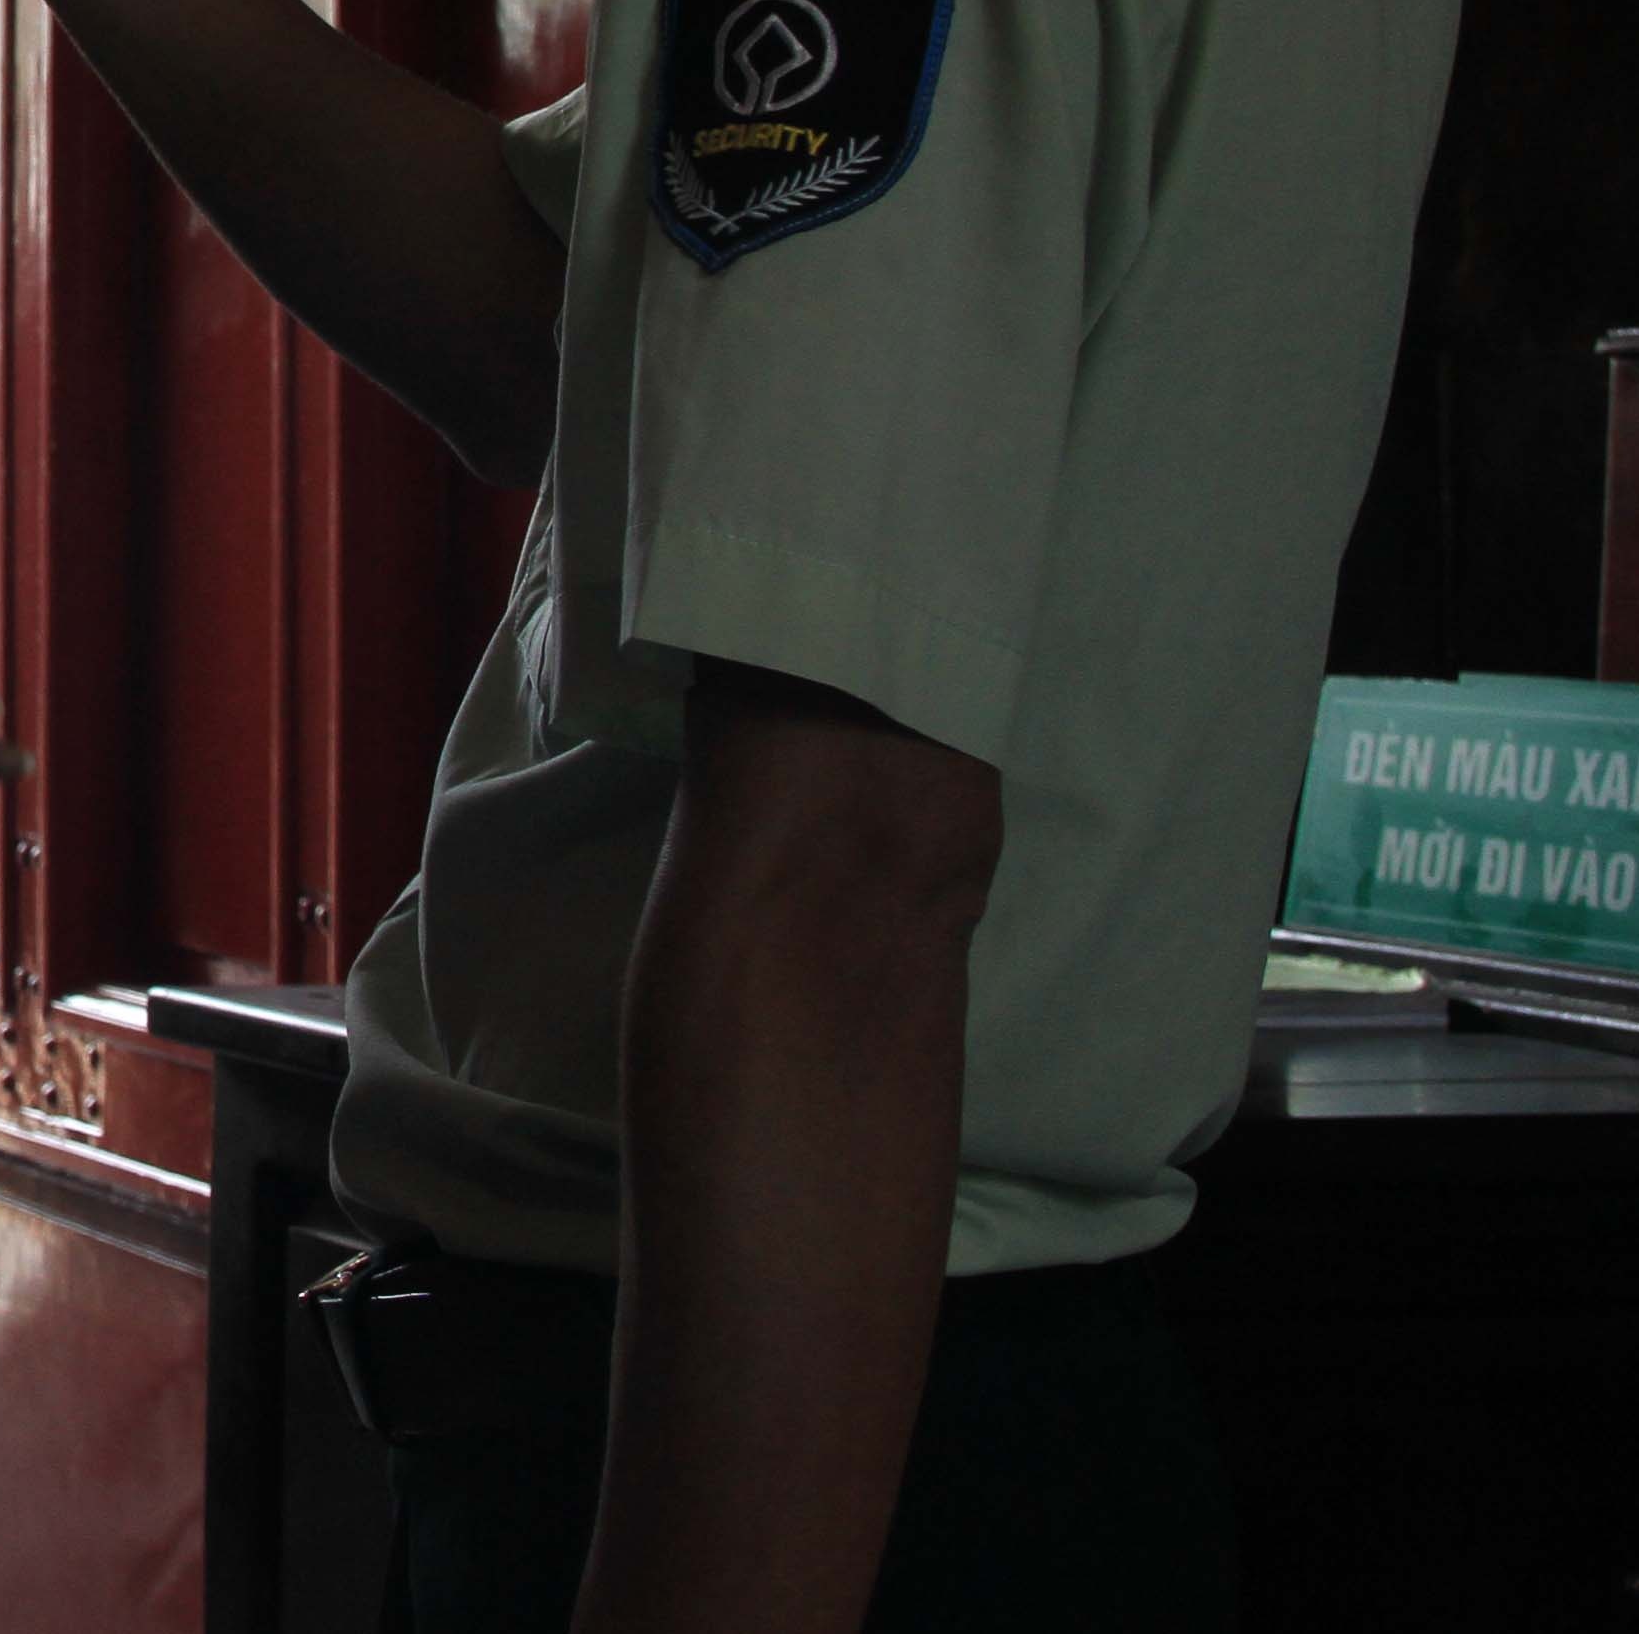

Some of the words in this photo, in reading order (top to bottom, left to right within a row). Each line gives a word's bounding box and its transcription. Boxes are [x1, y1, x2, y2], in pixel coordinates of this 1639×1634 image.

[692, 122, 831, 158] SECURITY
[1343, 719, 1436, 792] ĐÈN
[1445, 729, 1555, 803] MÀU
[1375, 817, 1466, 893] MỜI
[1476, 836, 1528, 899] ĐI
[1541, 835, 1637, 913] VÀO
